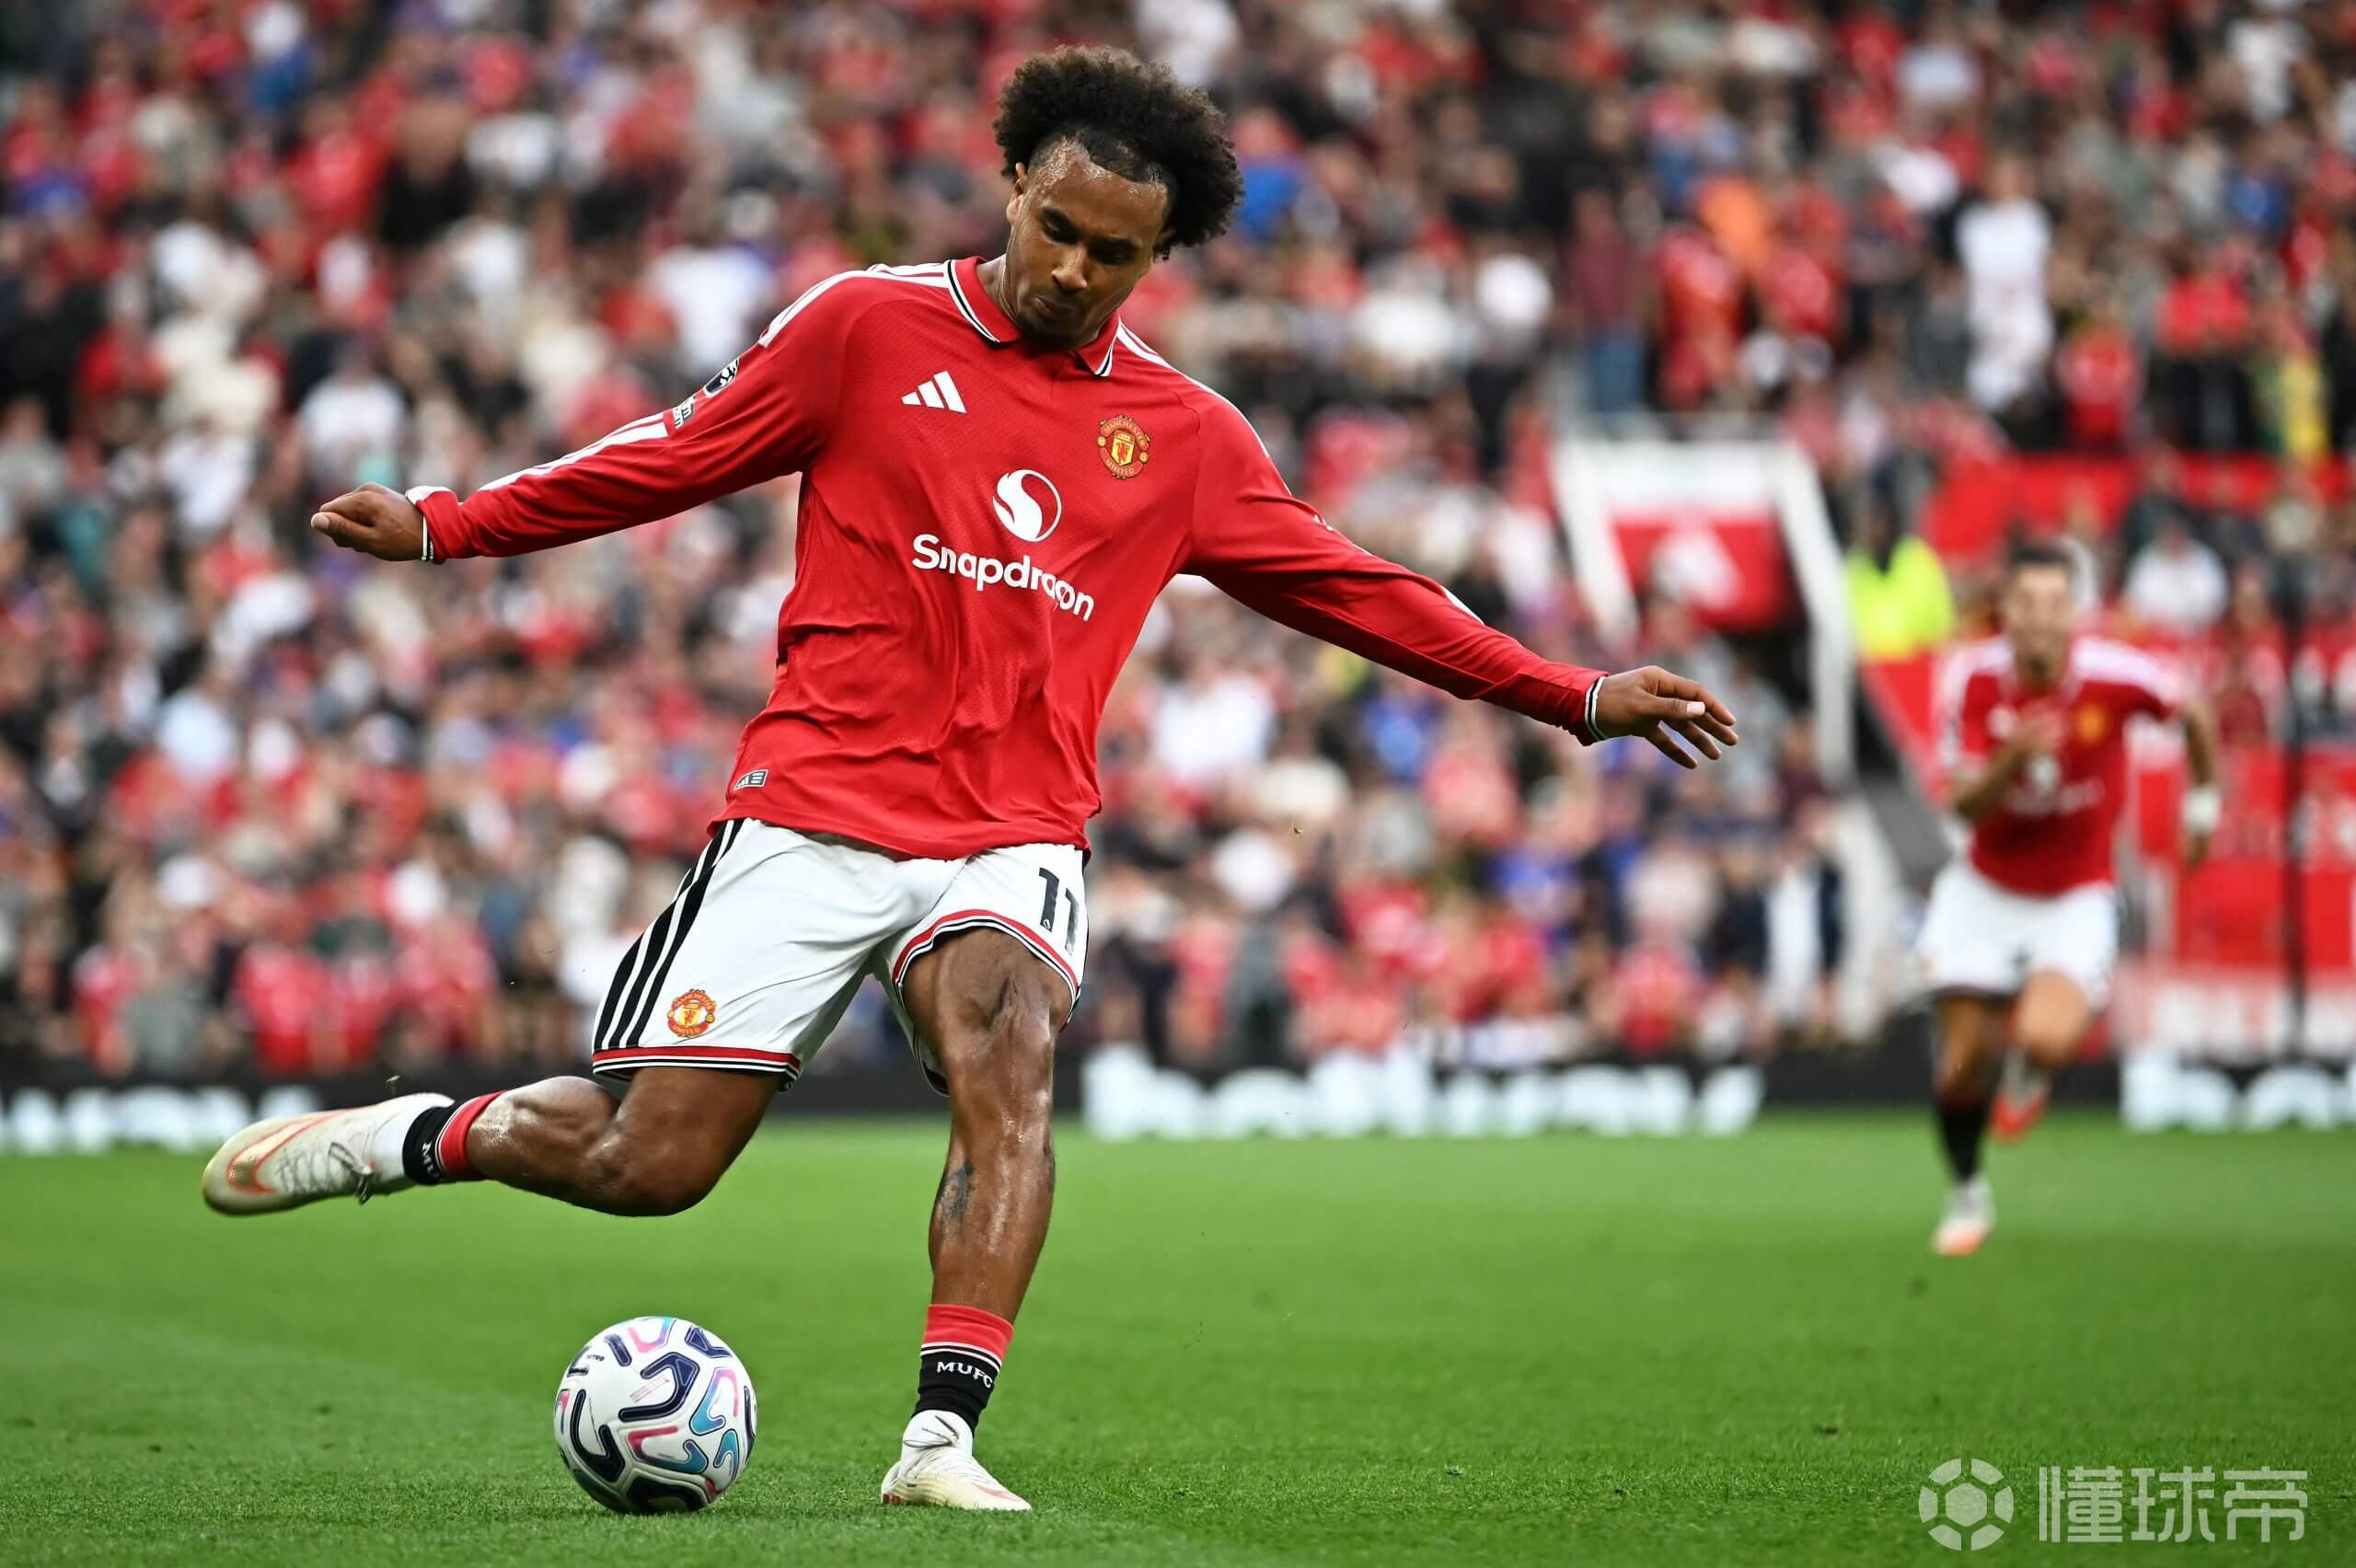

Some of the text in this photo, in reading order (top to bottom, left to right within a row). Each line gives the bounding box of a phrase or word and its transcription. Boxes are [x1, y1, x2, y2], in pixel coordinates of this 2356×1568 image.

[1105, 458, 1135, 476] UNITED
[1038, 867, 1080, 957] 11
[936, 1361, 994, 1389] MUFC
